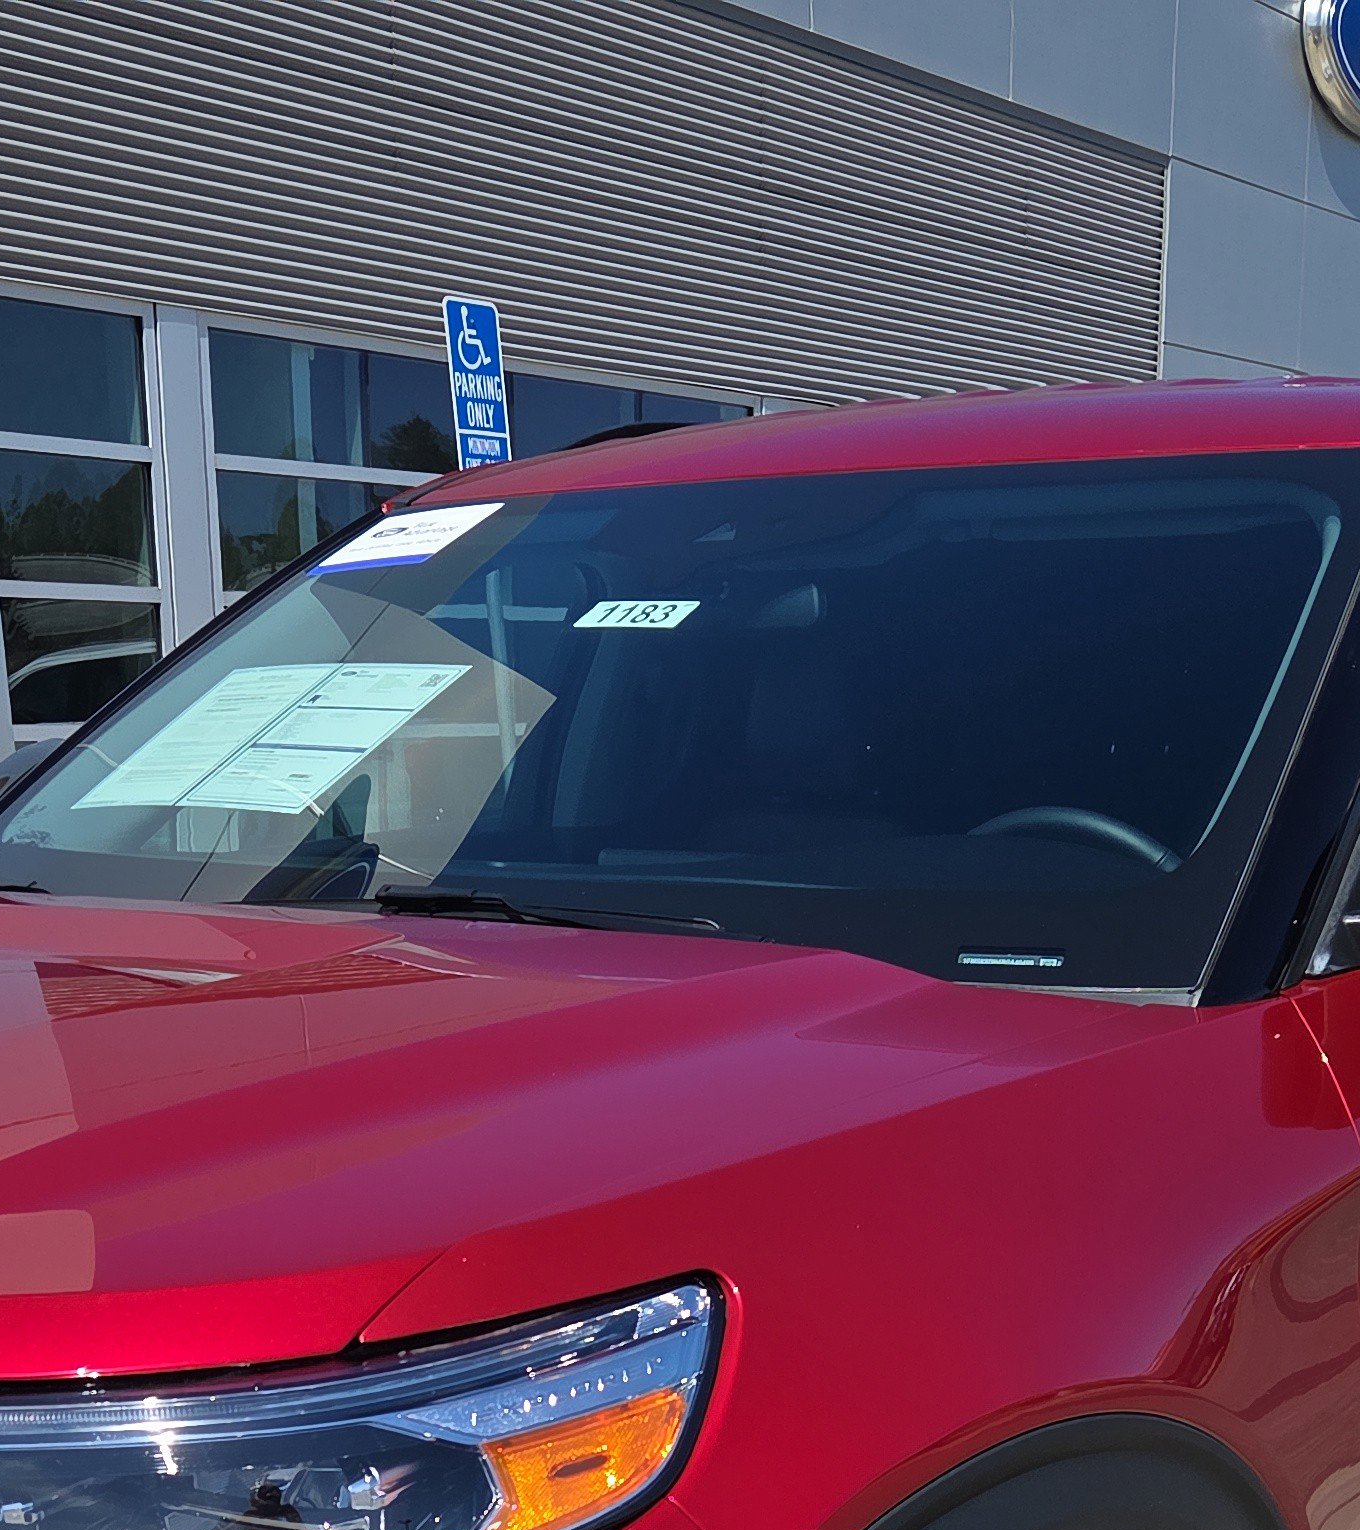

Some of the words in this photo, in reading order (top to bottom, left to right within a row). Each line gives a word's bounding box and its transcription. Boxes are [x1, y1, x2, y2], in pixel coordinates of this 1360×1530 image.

[454, 371, 503, 402] PARKING
[466, 401, 495, 429] ONLY
[596, 603, 678, 624] 1183
